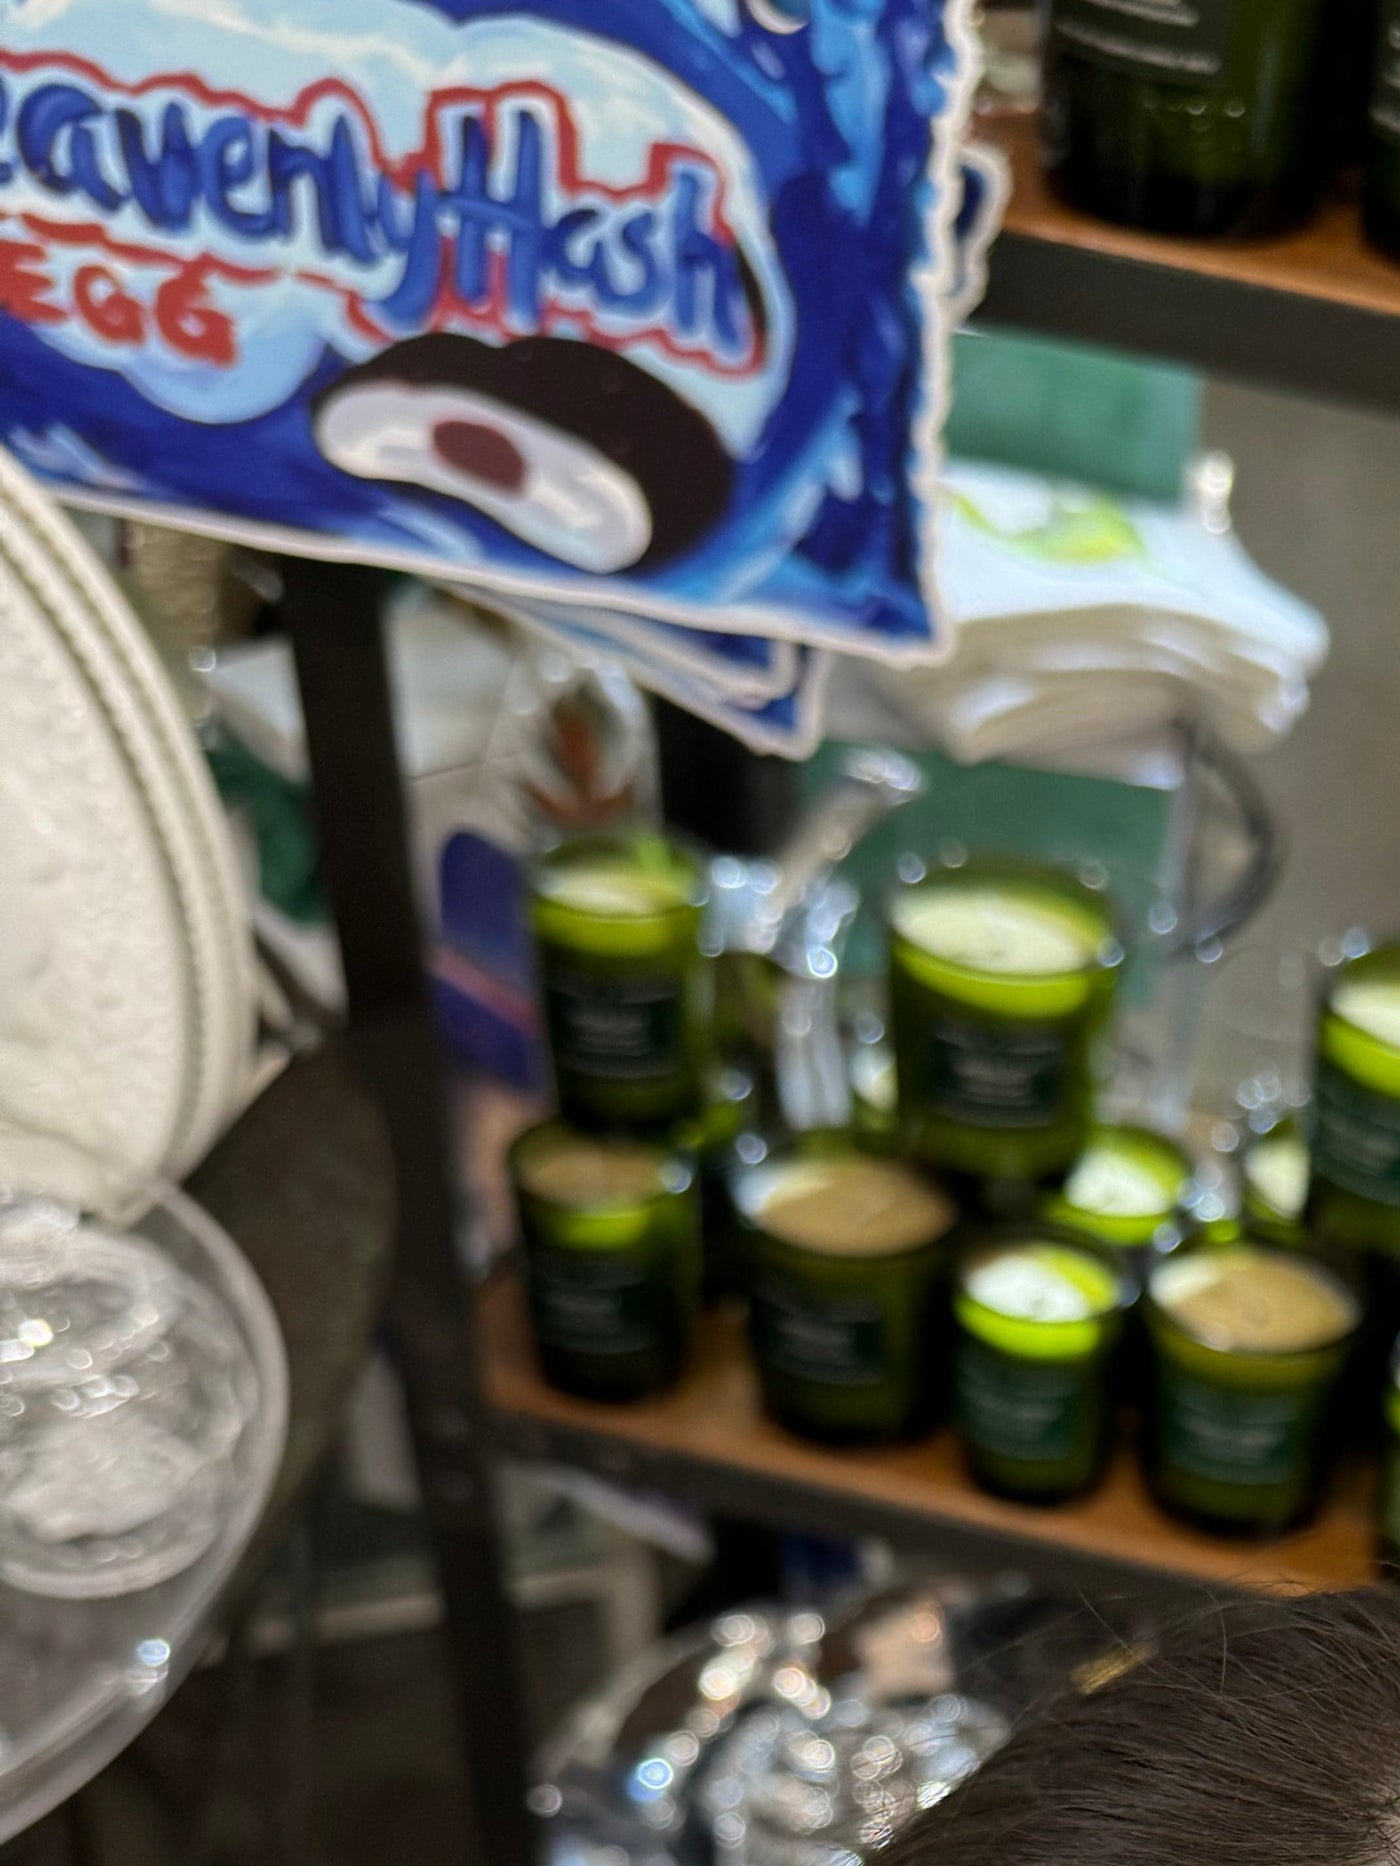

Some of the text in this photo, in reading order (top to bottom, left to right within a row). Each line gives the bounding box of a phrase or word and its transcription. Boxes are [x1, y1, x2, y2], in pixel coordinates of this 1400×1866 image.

[0, 78, 742, 352] avenly Hash
[0, 238, 238, 368] EGG
